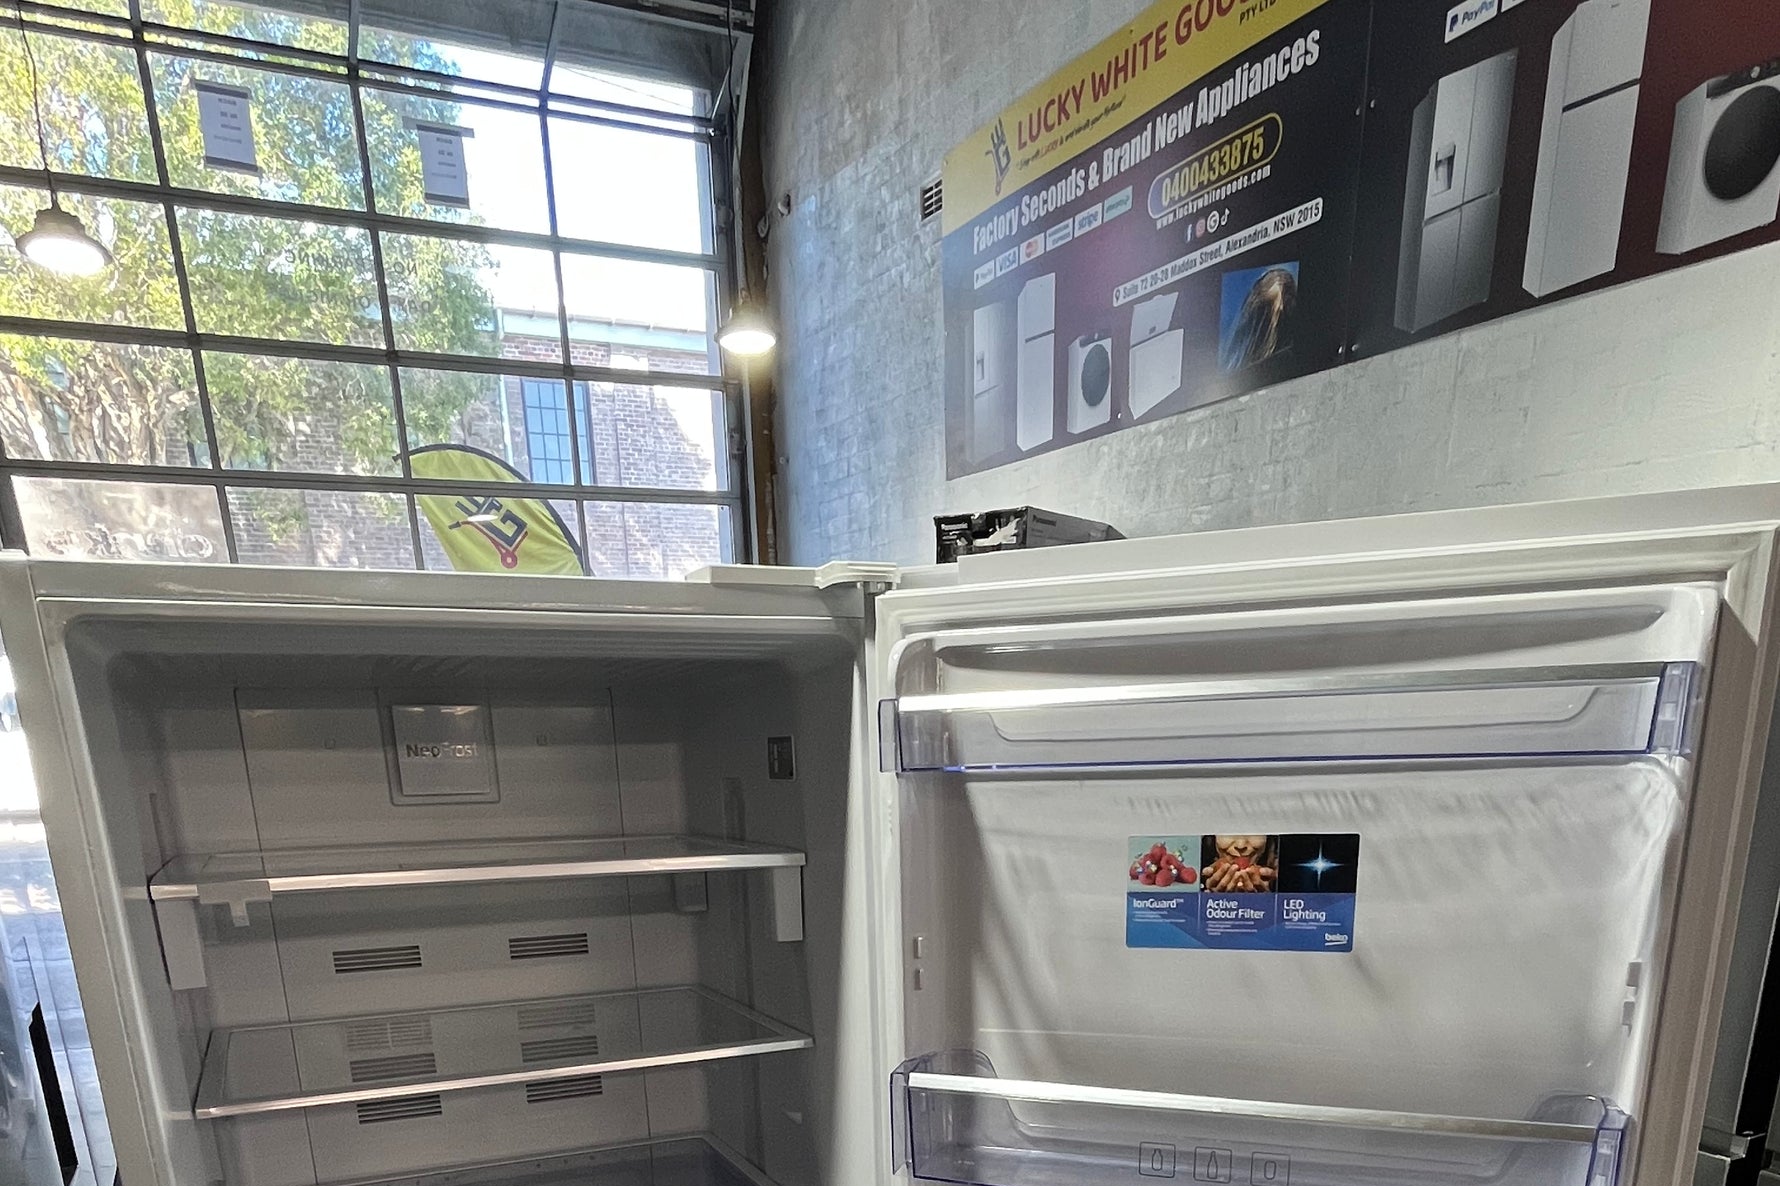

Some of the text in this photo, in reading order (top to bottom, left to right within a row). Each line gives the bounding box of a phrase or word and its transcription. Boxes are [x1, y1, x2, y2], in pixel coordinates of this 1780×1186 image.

[1239, 4, 1258, 25] PTY
[1017, 0, 1248, 150] LUCKY WHITE GO
[973, 205, 1020, 255] Factory
[1021, 168, 1086, 226] Seconds
[1088, 161, 1100, 191] &
[1103, 122, 1152, 183] Brand
[1155, 102, 1194, 152] New
[1196, 29, 1320, 128] Appliances
[1162, 126, 1265, 207] 0400433875
[1156, 165, 1271, 230] www.luckywhitegoods.com
[1273, 212, 1296, 234] NSW
[1297, 202, 1320, 224] 2015
[998, 250, 1017, 272] VISA
[1206, 899, 1239, 909] Active
[1206, 908, 1266, 919] Odour Filter
[1283, 899, 1305, 909] LED
[1283, 909, 1327, 921] Lighting
[1325, 933, 1349, 943] beko
